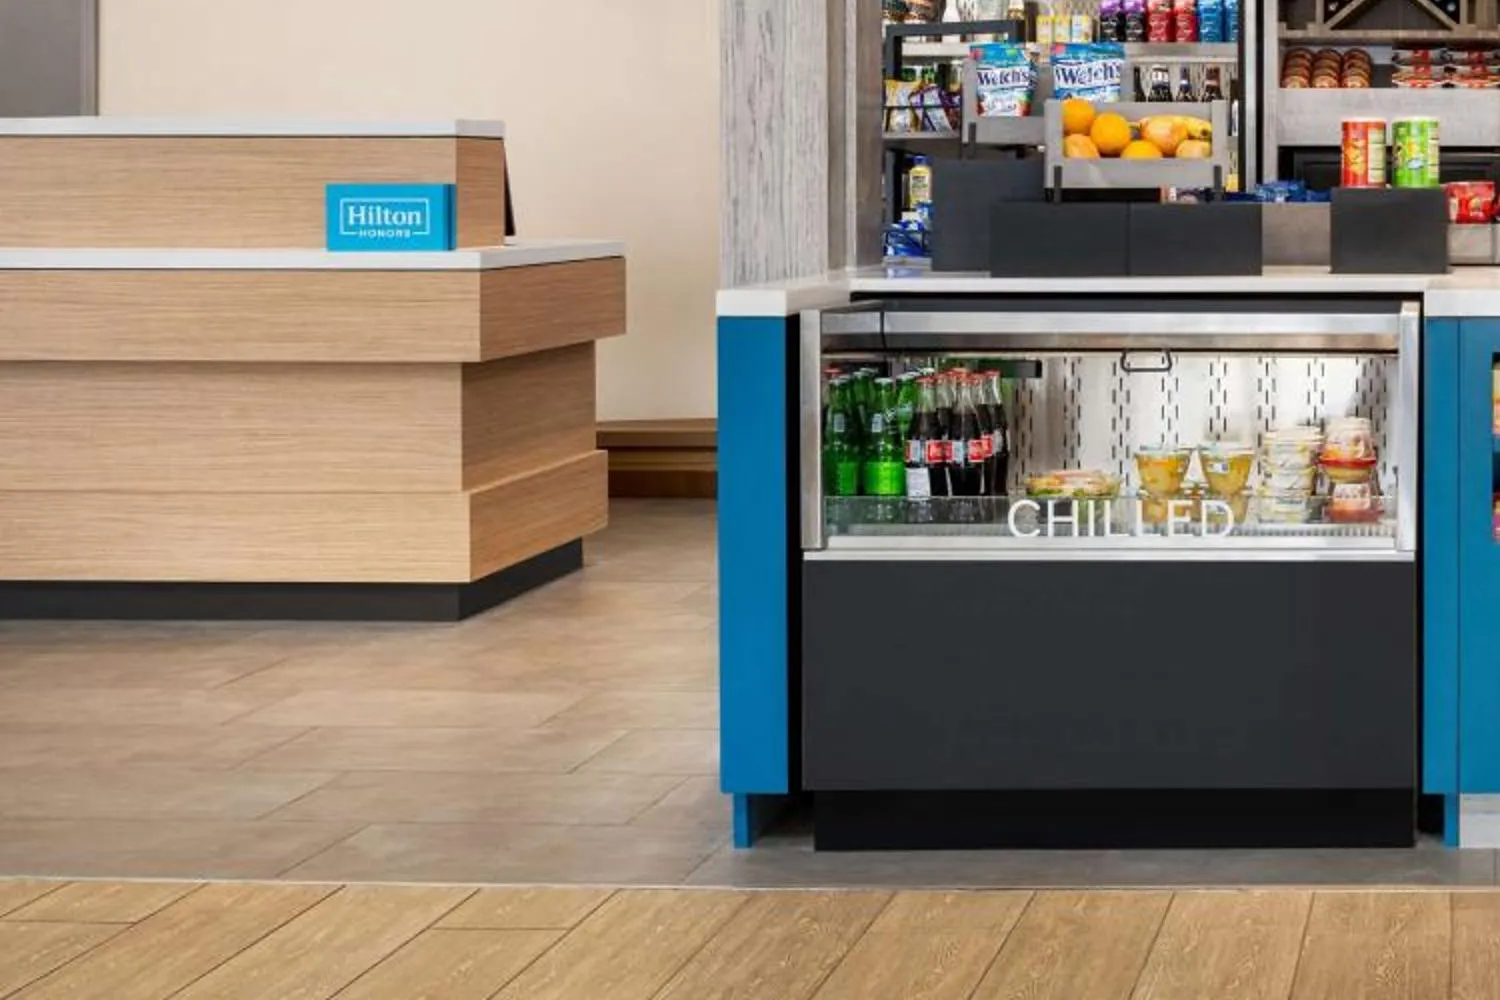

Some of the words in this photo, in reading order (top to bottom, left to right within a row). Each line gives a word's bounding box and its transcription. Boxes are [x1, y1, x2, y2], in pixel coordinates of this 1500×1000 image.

[348, 205, 421, 226] Hilton
[359, 228, 411, 238] HONORS
[1007, 500, 1235, 538] CHILLED
